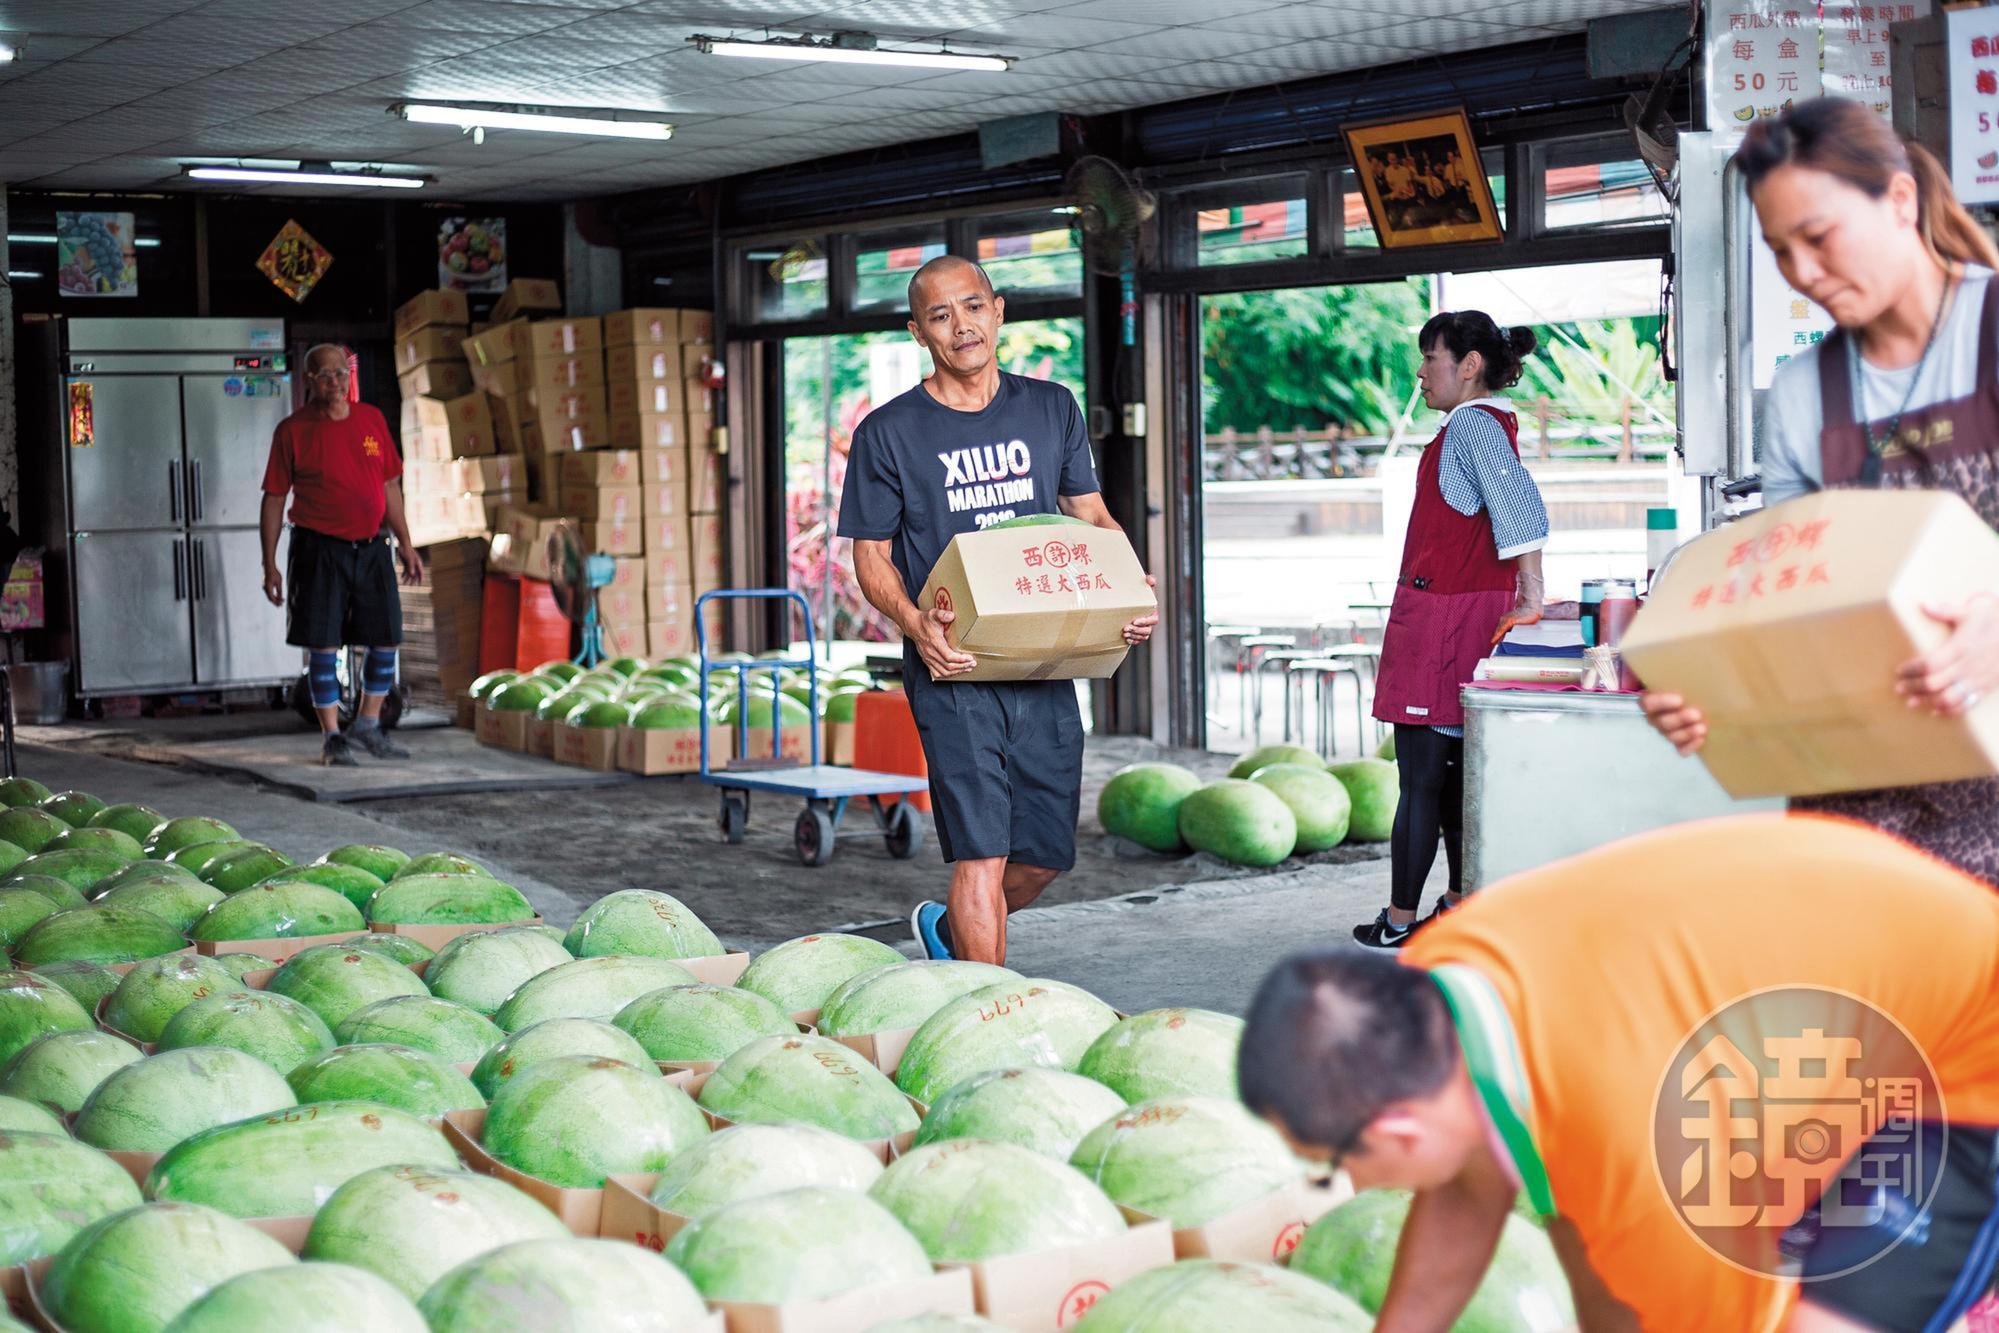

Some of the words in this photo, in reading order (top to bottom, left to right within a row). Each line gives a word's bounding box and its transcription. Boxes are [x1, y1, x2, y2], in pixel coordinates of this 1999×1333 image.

[1729, 10, 1800, 30] 西瓜外帶
[1870, 51, 1886, 67] 至
[938, 439, 1031, 488] XILUO
[947, 478, 1034, 512] MARATHON
[1015, 573, 1112, 595] 特選大西瓜
